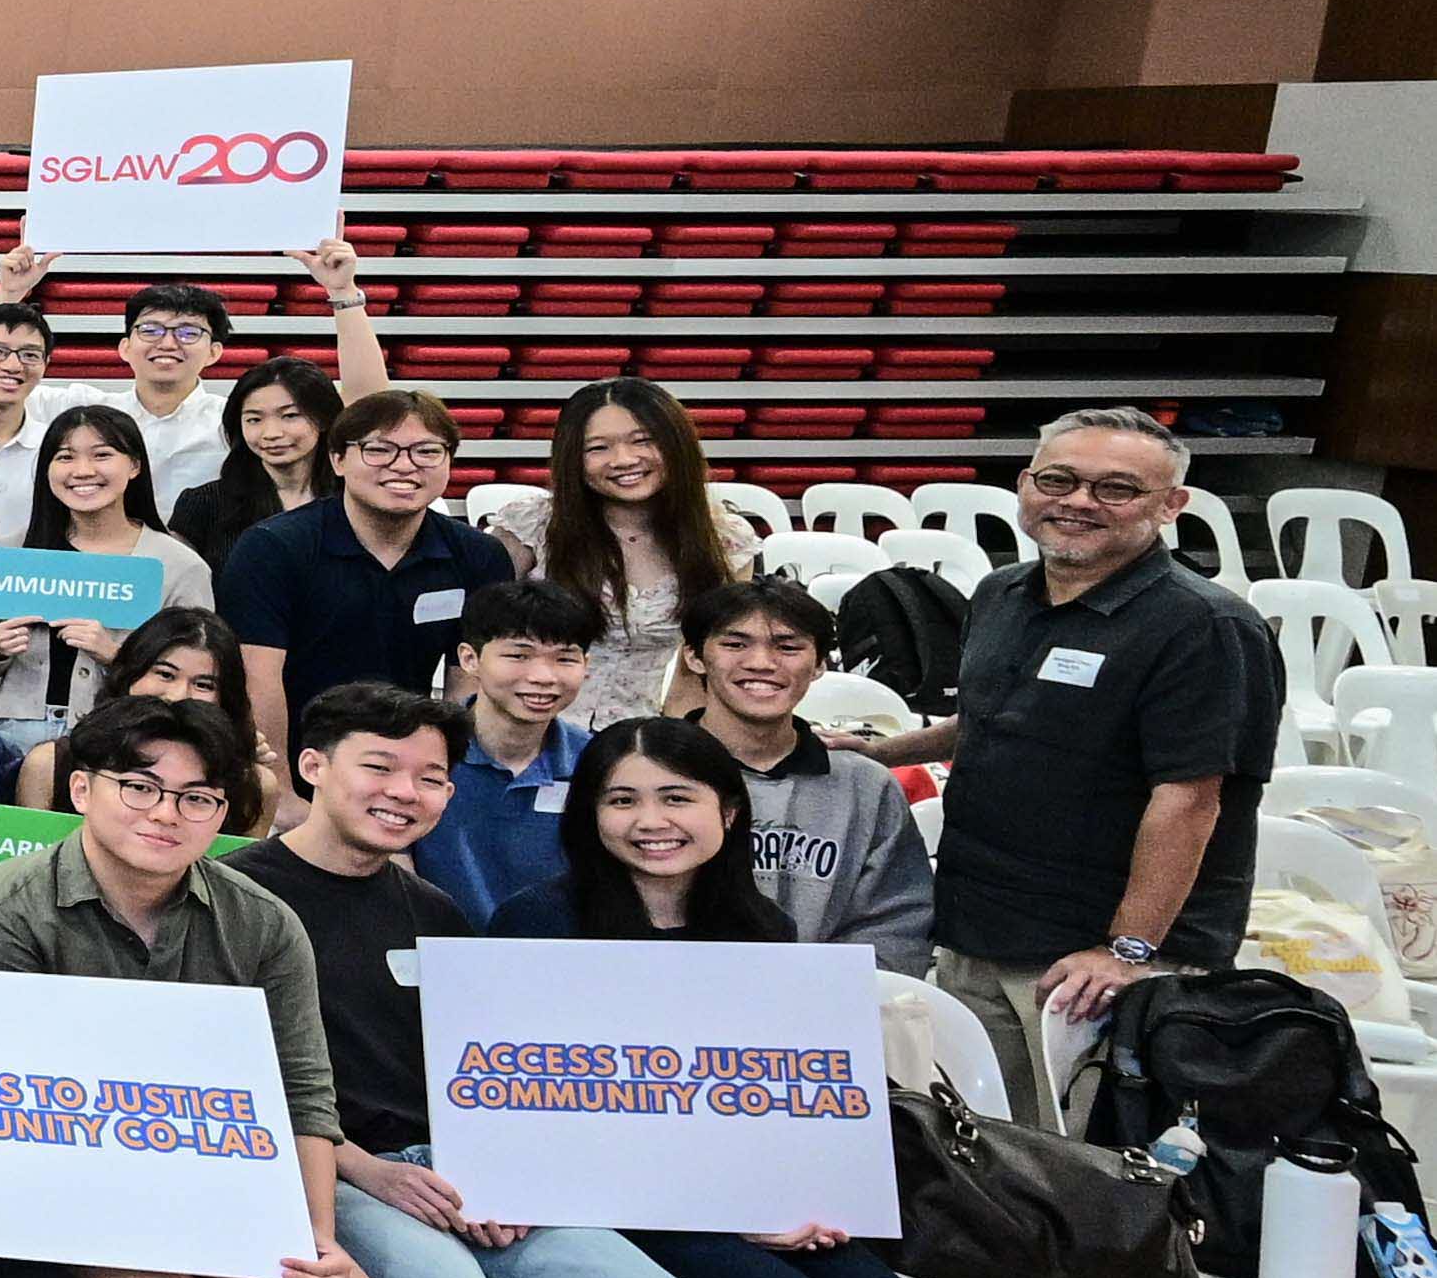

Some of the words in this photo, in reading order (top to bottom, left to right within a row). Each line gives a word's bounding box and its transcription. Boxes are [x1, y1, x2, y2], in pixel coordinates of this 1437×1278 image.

[458, 1041, 617, 1079] ACCESS
[622, 1045, 682, 1079] TO
[689, 1046, 852, 1083] JUSTICE
[26, 1074, 89, 1111] TO
[95, 1080, 257, 1123] JUSTICE
[447, 1076, 701, 1114] COMMUNITY
[707, 1082, 871, 1120] CO-LAB
[114, 1117, 278, 1161] CO-LAB
